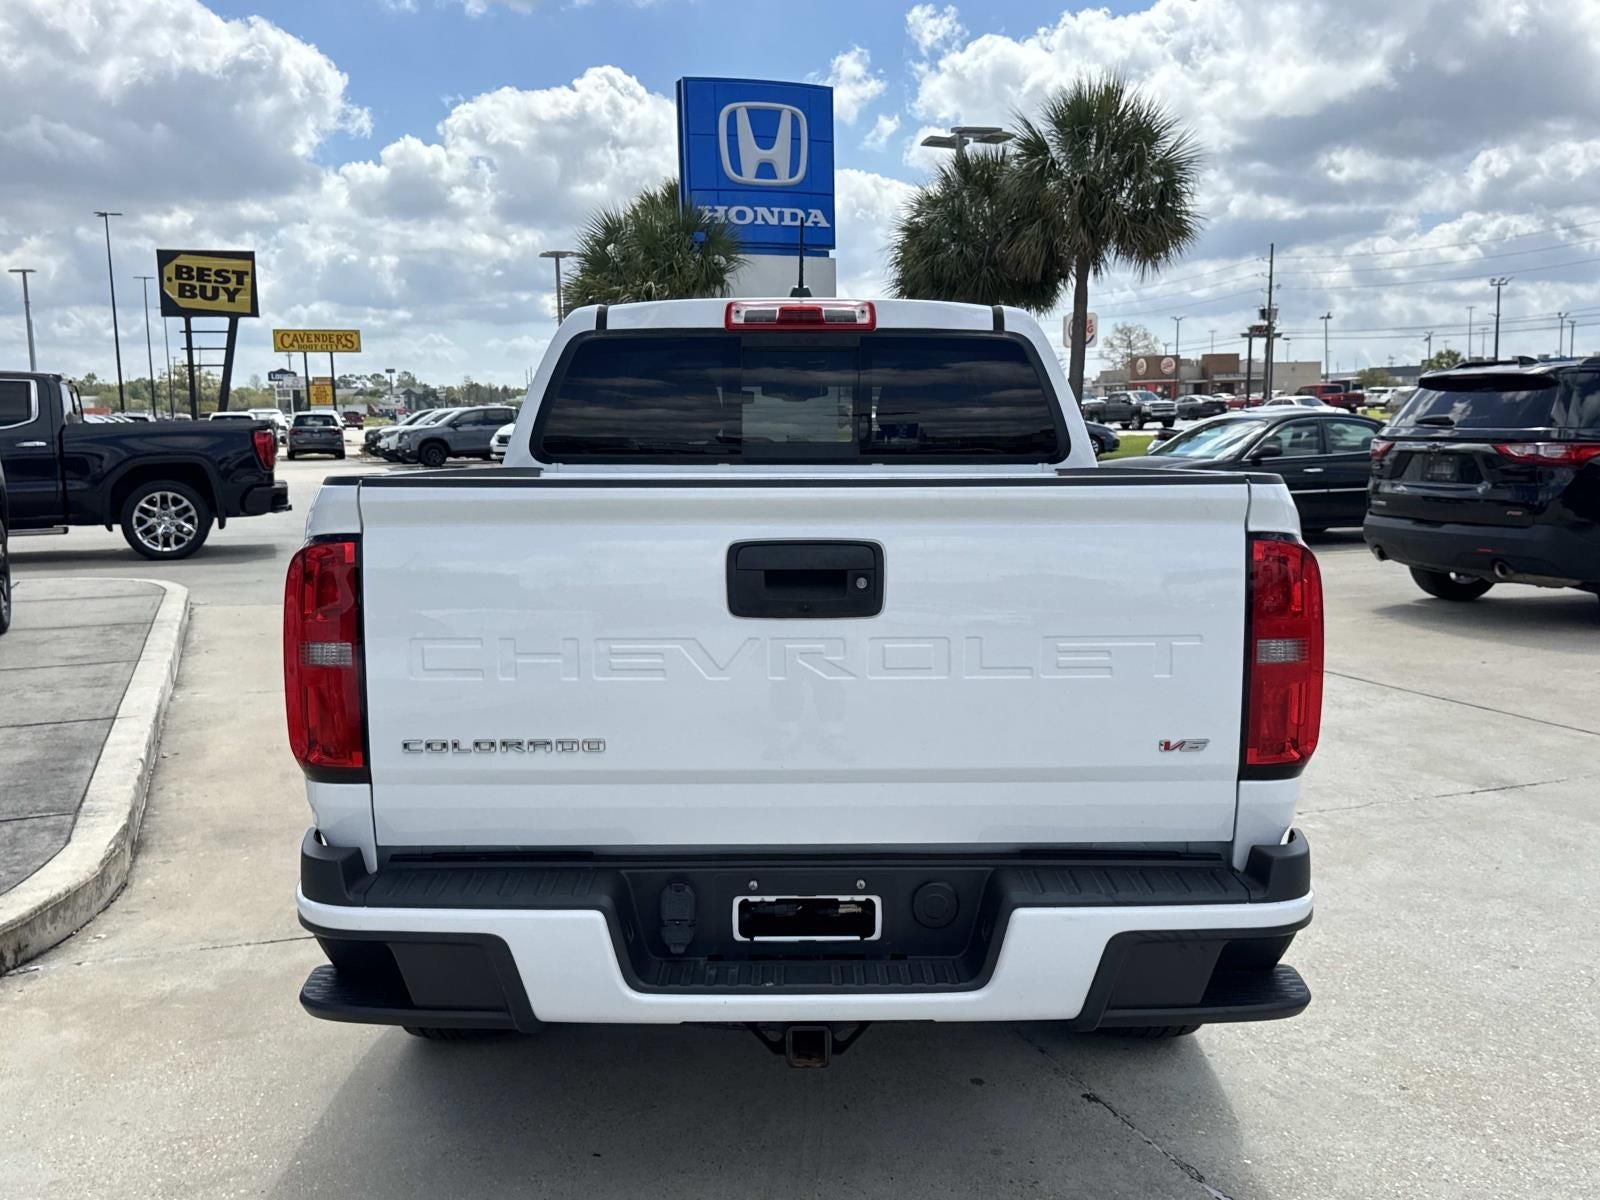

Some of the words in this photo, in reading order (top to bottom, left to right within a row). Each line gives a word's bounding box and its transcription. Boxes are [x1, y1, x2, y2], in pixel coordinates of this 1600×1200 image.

[697, 205, 831, 227] HONDA
[174, 264, 249, 286] BEST
[178, 282, 242, 303] BUY
[280, 332, 355, 349] CAVENDER'S
[409, 635, 1203, 681] CHEVROLET
[401, 738, 607, 753] COLORADO
[1159, 738, 1210, 752] V6
